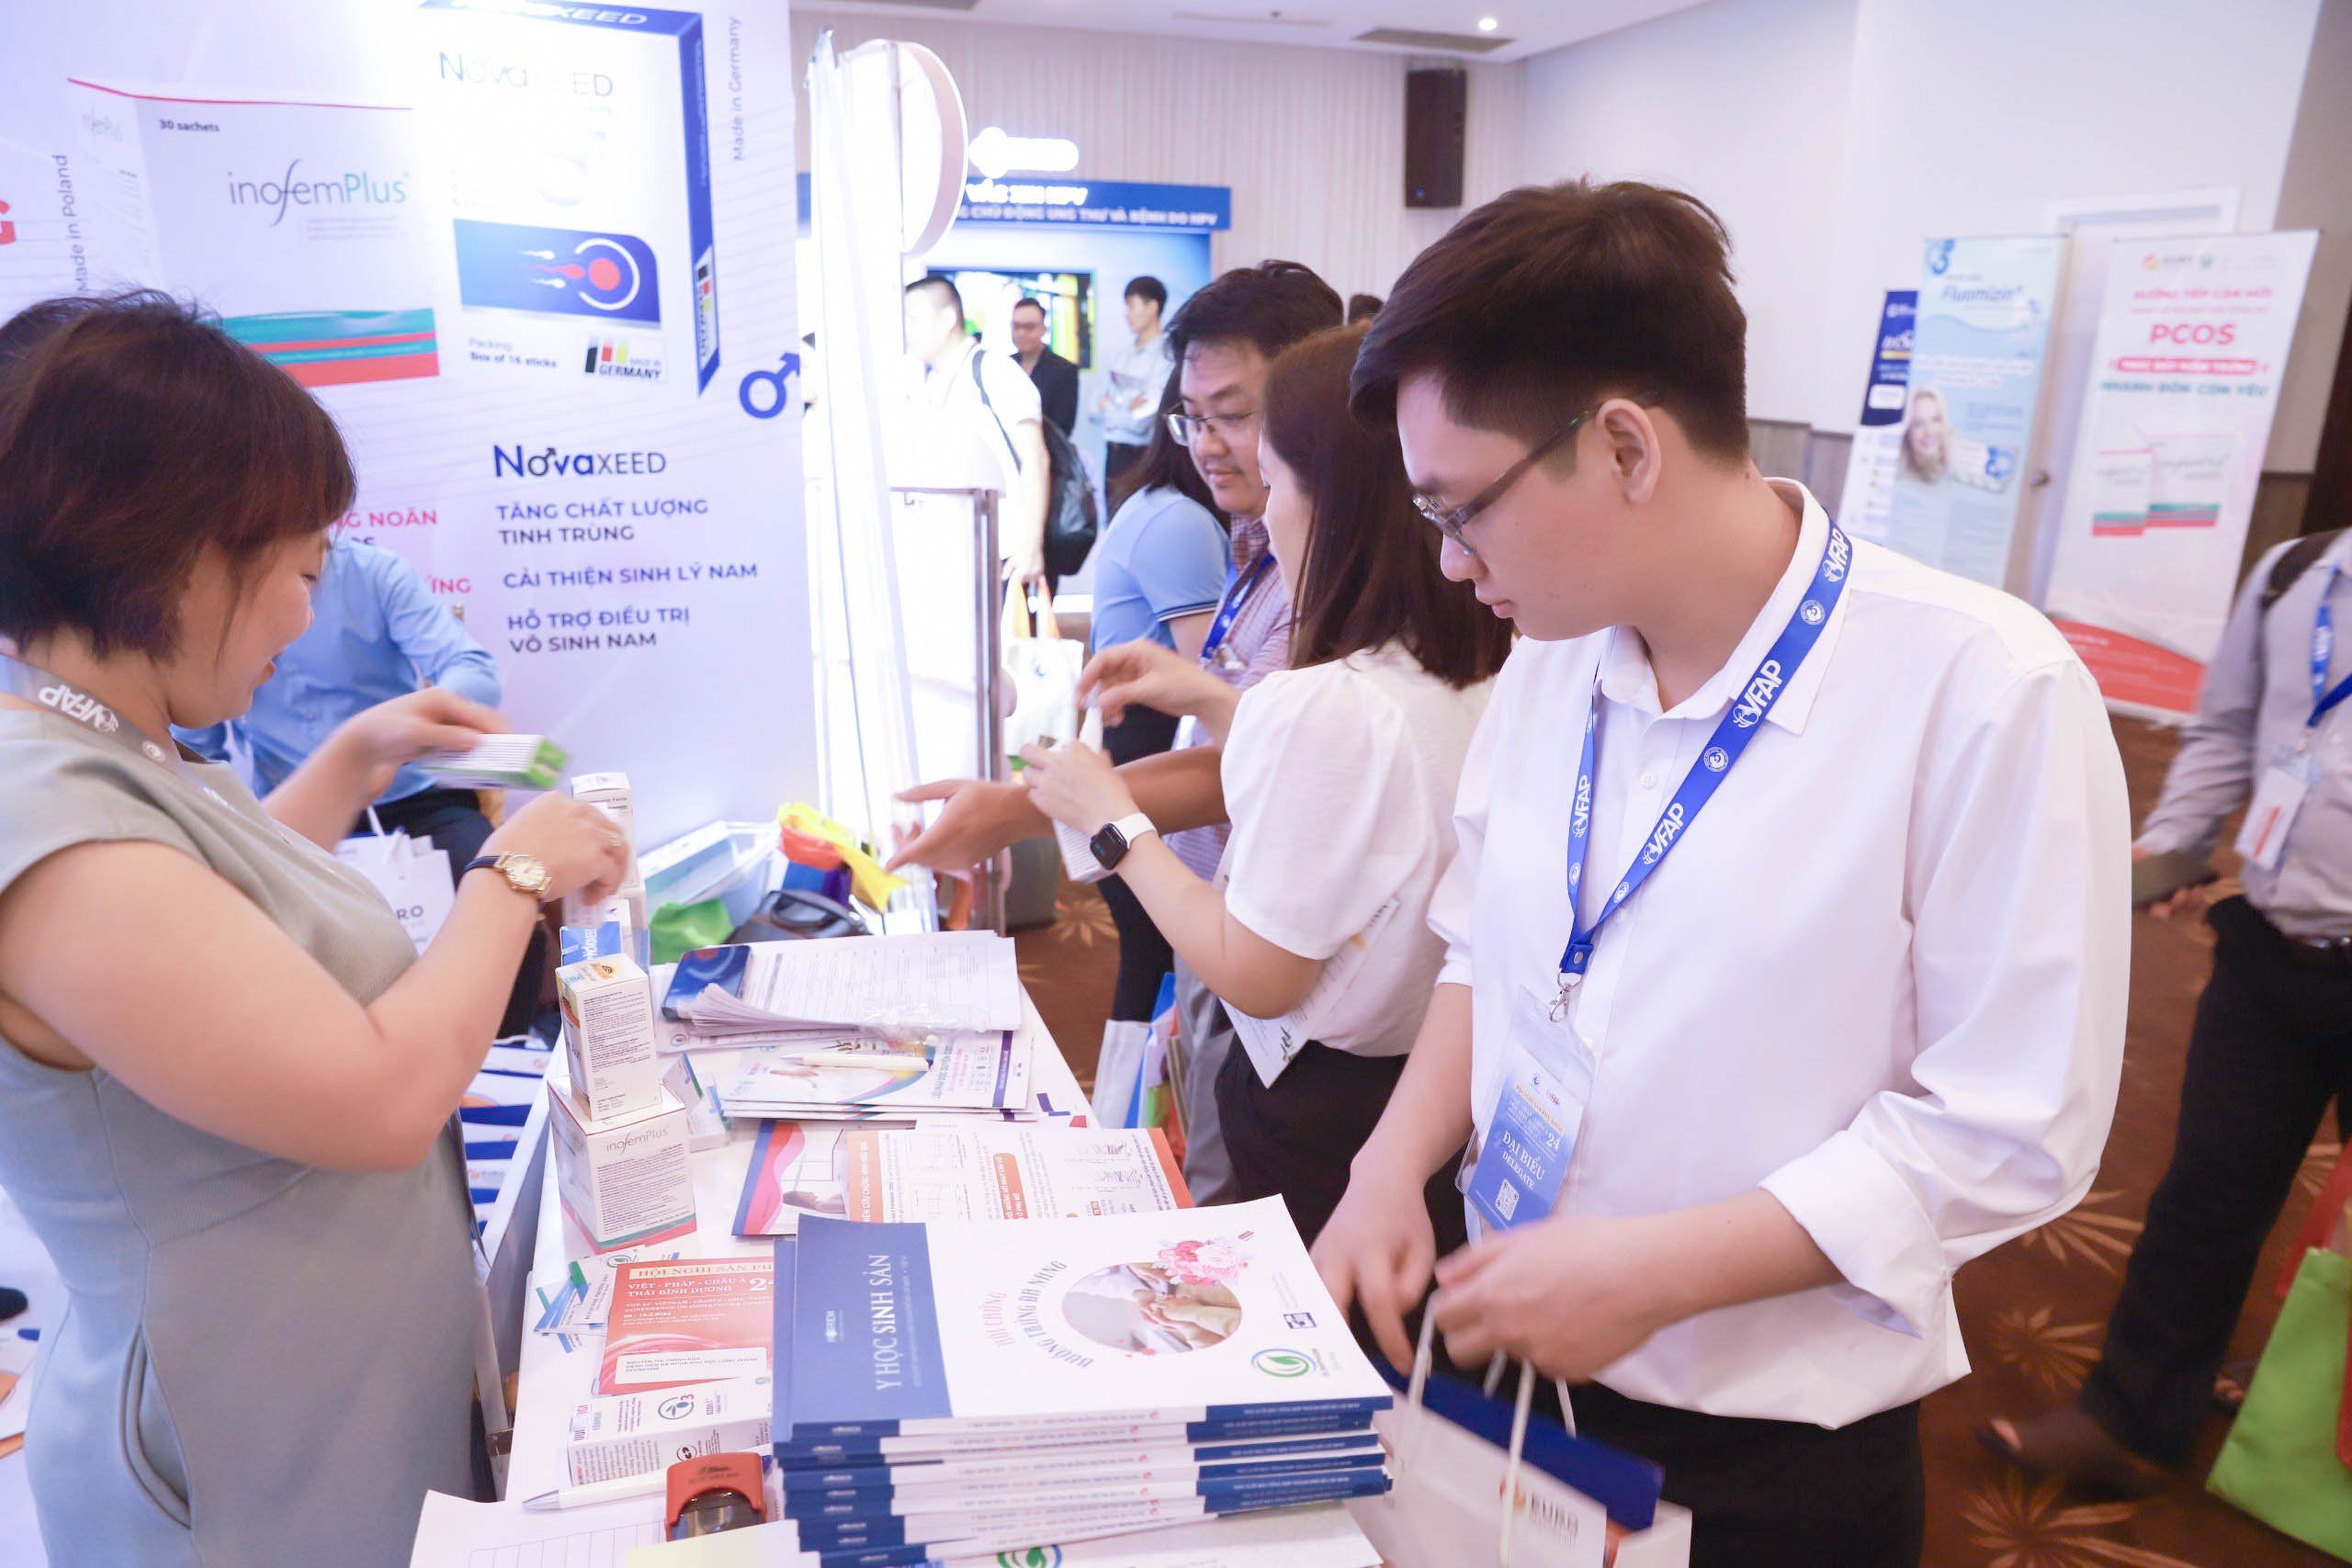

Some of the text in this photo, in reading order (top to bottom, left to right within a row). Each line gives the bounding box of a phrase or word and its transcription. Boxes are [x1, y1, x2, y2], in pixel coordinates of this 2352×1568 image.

[439, 51, 614, 97] NovaED
[728, 17, 744, 161] Made in Germany
[158, 118, 220, 134] 30 sachets
[52, 154, 78, 217] Poland
[70, 243, 89, 292] Made
[2149, 322, 2237, 346] PCOS
[597, 363, 662, 380] GERMANY
[368, 506, 438, 528] NOÃN
[496, 496, 709, 521] TĂNG CHẤT LƯỢNG
[499, 522, 636, 546] TINH TRÙNG
[1826, 527, 1852, 575] VFAP
[503, 567, 541, 589] CẢI
[547, 566, 614, 588] THIỆN
[619, 567, 672, 584] SINH
[709, 563, 759, 580] NAM
[507, 606, 542, 631] HỖ
[546, 609, 593, 630] TRỢ
[656, 606, 691, 626] TRỊ
[509, 632, 658, 654] VÔ SINH NAM
[38, 684, 106, 730] VFAP
[1739, 658, 1783, 721] VFAP
[1573, 774, 1593, 829] VFAP
[1647, 802, 1687, 856] VFAP
[396, 905, 424, 920] RO
[862, 1254, 904, 1392] Y HỌC SINH SẢN
